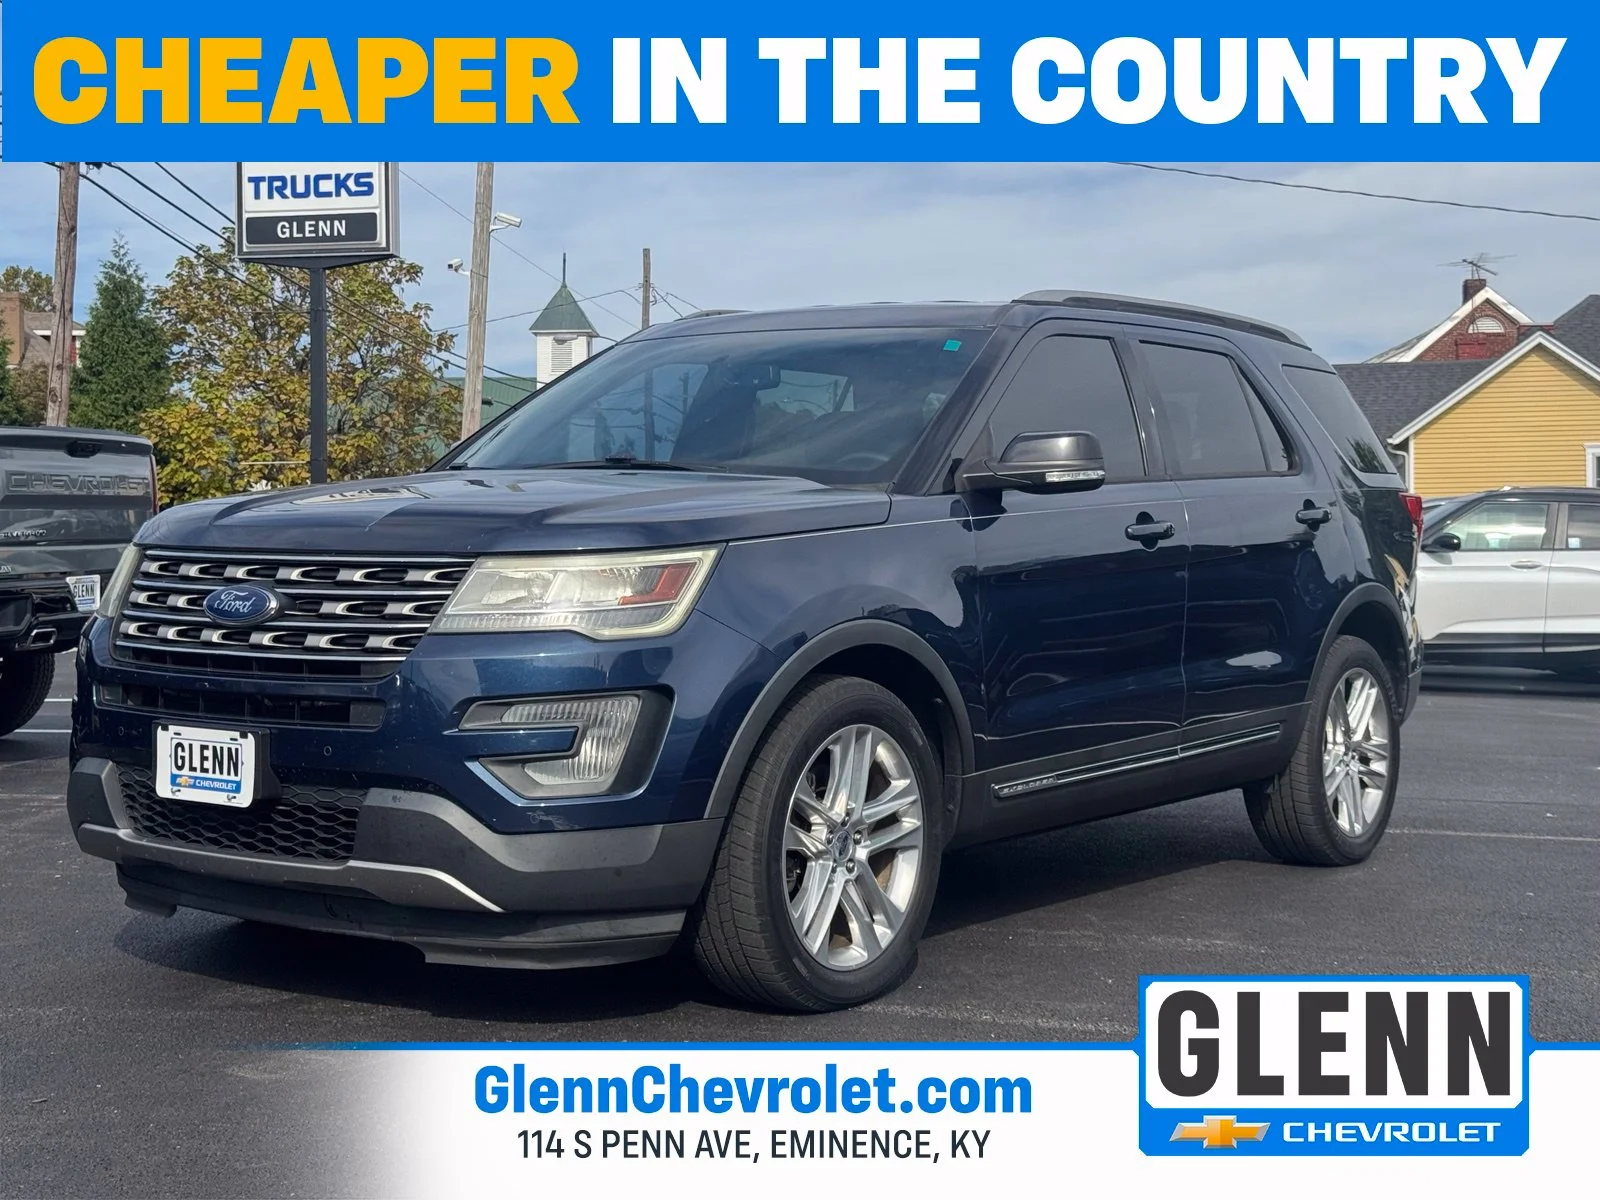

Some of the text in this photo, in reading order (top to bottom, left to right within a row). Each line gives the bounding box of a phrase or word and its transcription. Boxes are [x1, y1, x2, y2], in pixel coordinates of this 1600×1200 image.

[247, 172, 374, 200] TRUCKS
[277, 220, 346, 238] GLENN
[7, 473, 150, 494] CHEVROLET
[73, 584, 95, 598] GLENN
[214, 590, 255, 613] Ford
[174, 742, 239, 777] GLENN
[195, 779, 236, 790] CHEVROLET
